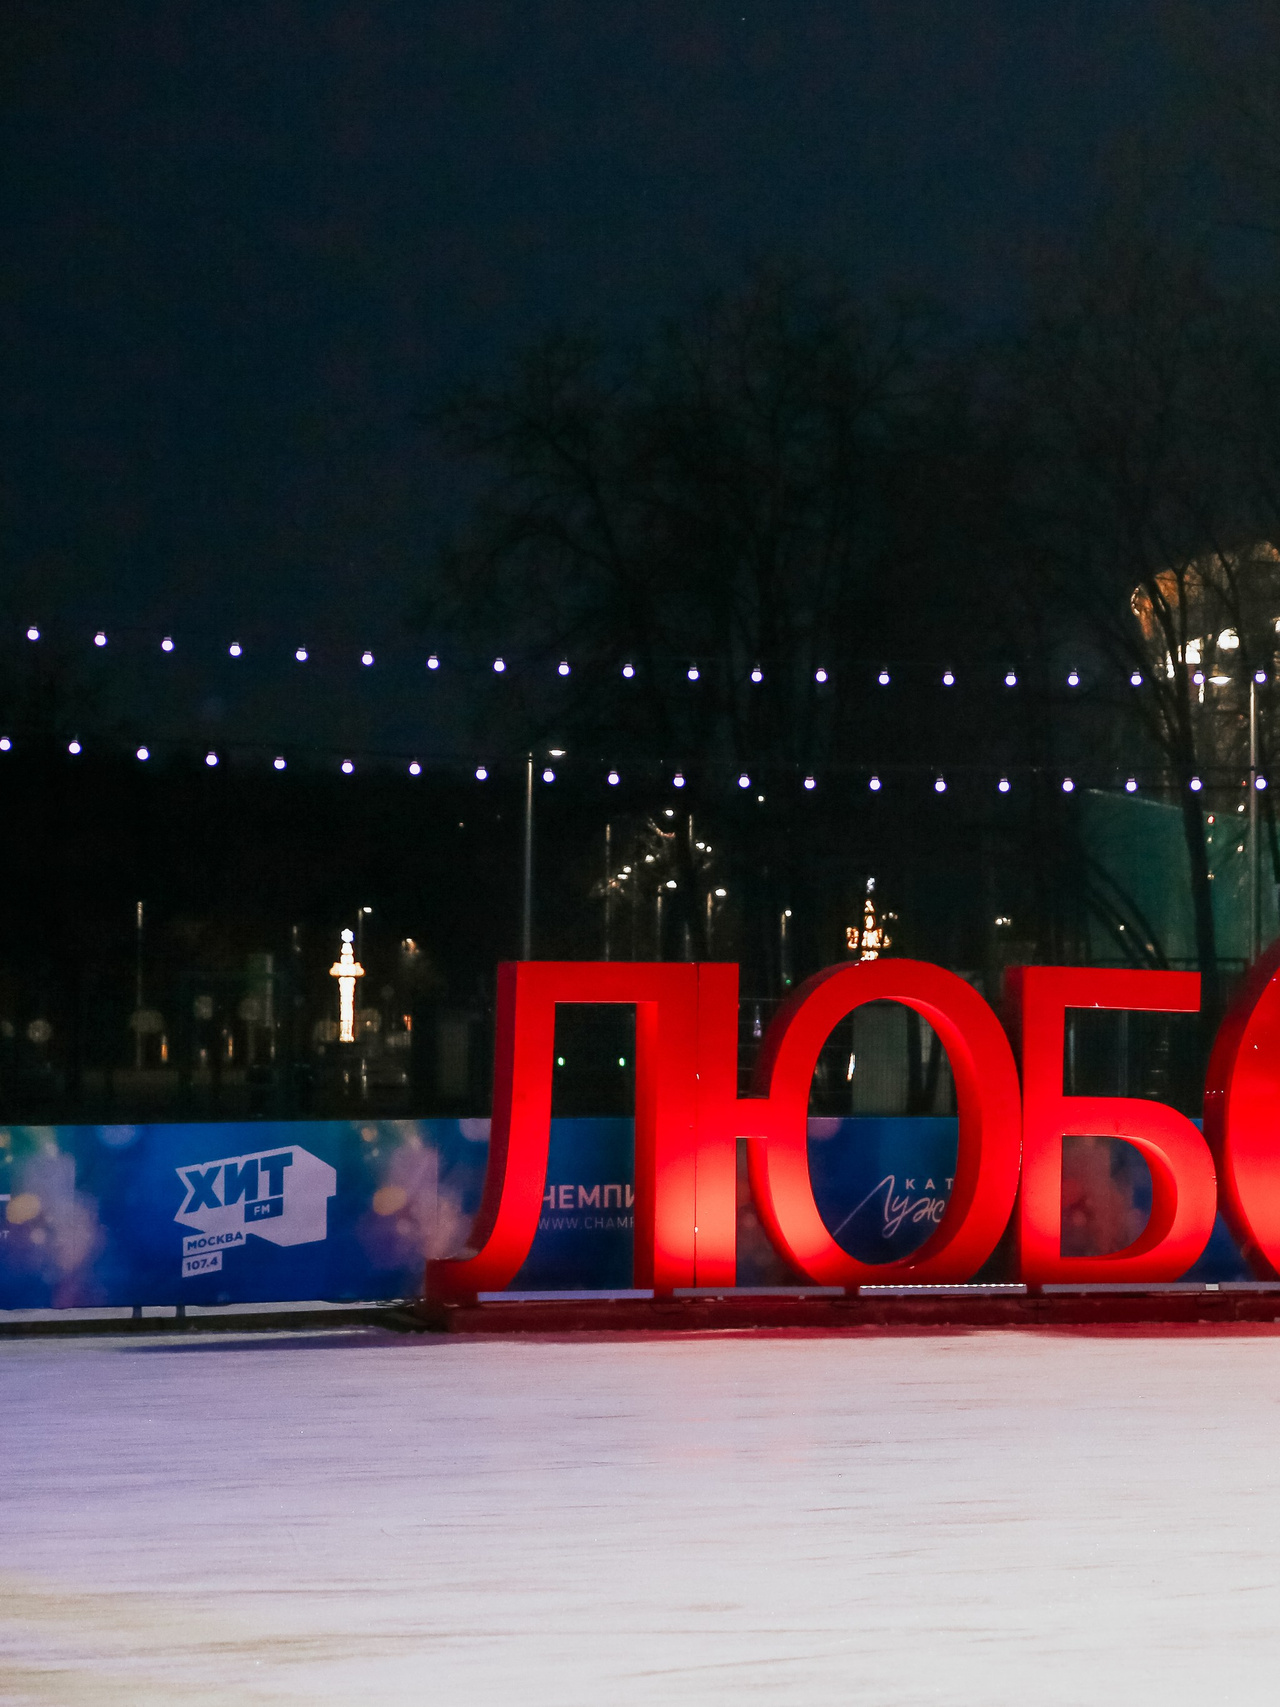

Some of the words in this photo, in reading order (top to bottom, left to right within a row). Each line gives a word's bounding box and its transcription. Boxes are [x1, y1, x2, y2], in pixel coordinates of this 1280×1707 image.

[184, 1152, 293, 1214] ХИТ
[254, 1203, 270, 1216] FM
[187, 1231, 244, 1251] МОСКВА
[186, 1256, 218, 1272] 107.4
